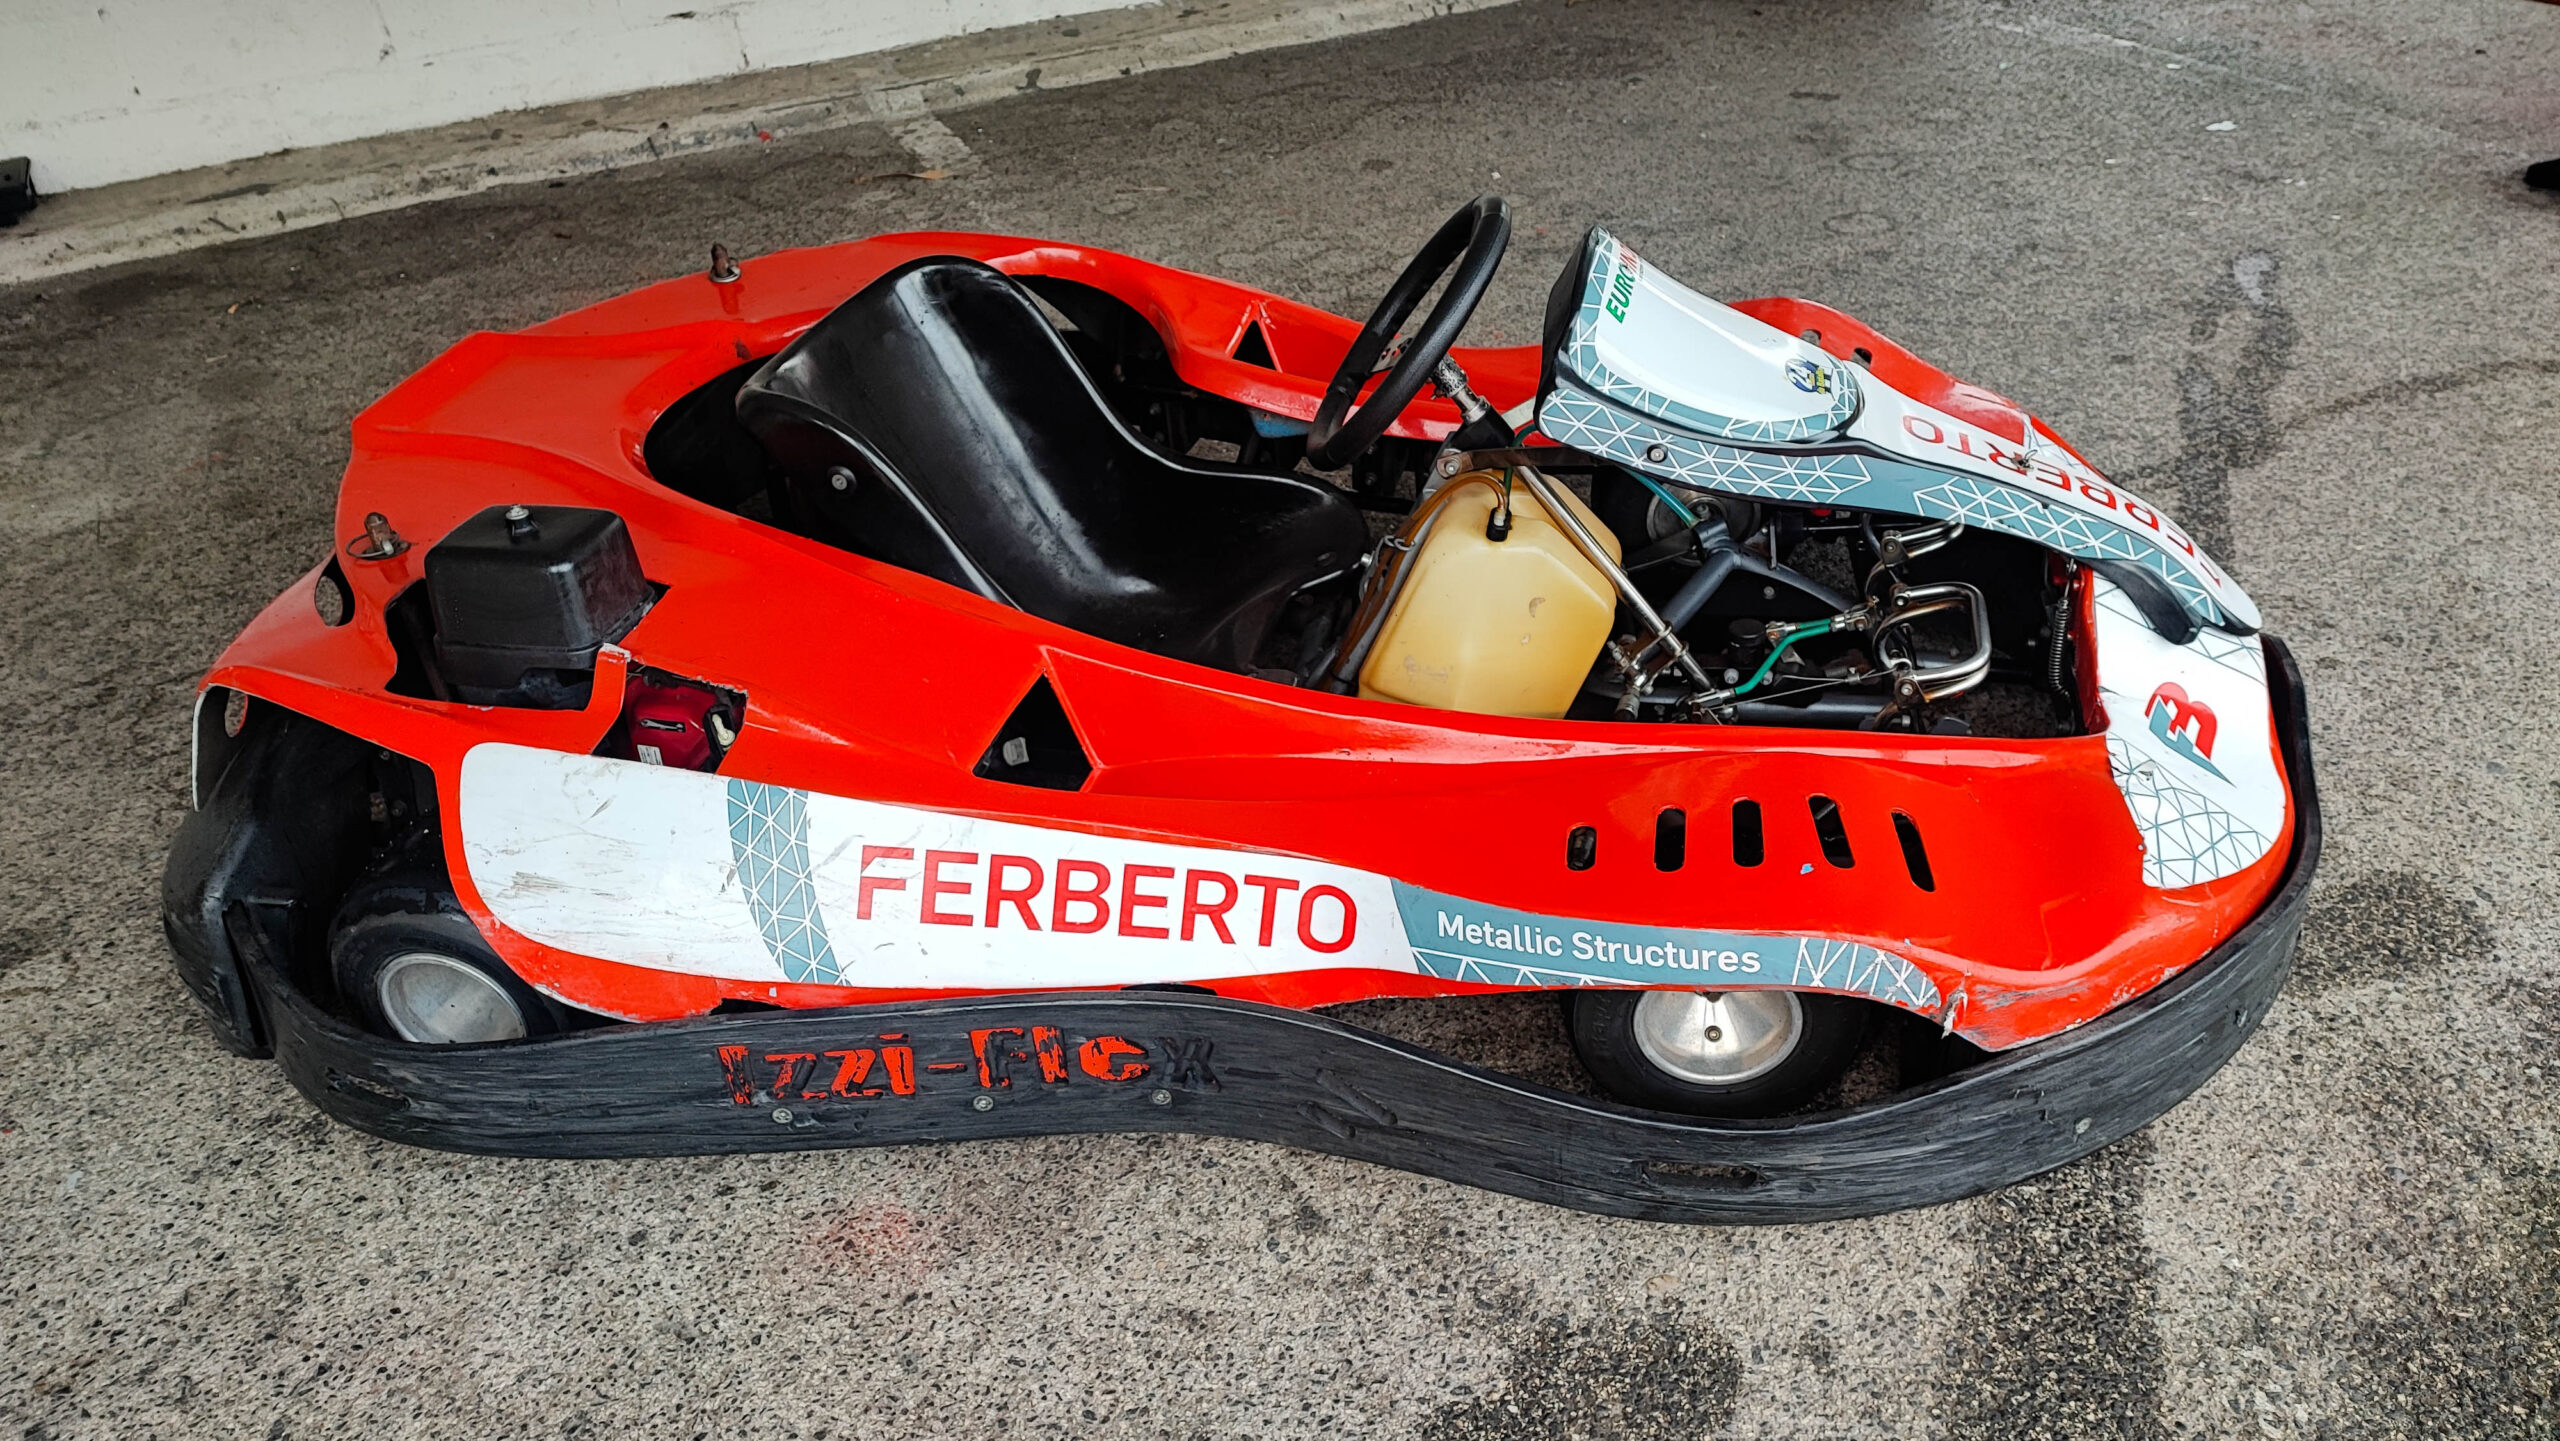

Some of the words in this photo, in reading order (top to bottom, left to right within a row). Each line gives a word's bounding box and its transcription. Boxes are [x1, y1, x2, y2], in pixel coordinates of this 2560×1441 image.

[856, 844, 1357, 953] FERBERTO
[1436, 910, 1563, 957] Metallic
[1571, 931, 1762, 974] Structures
